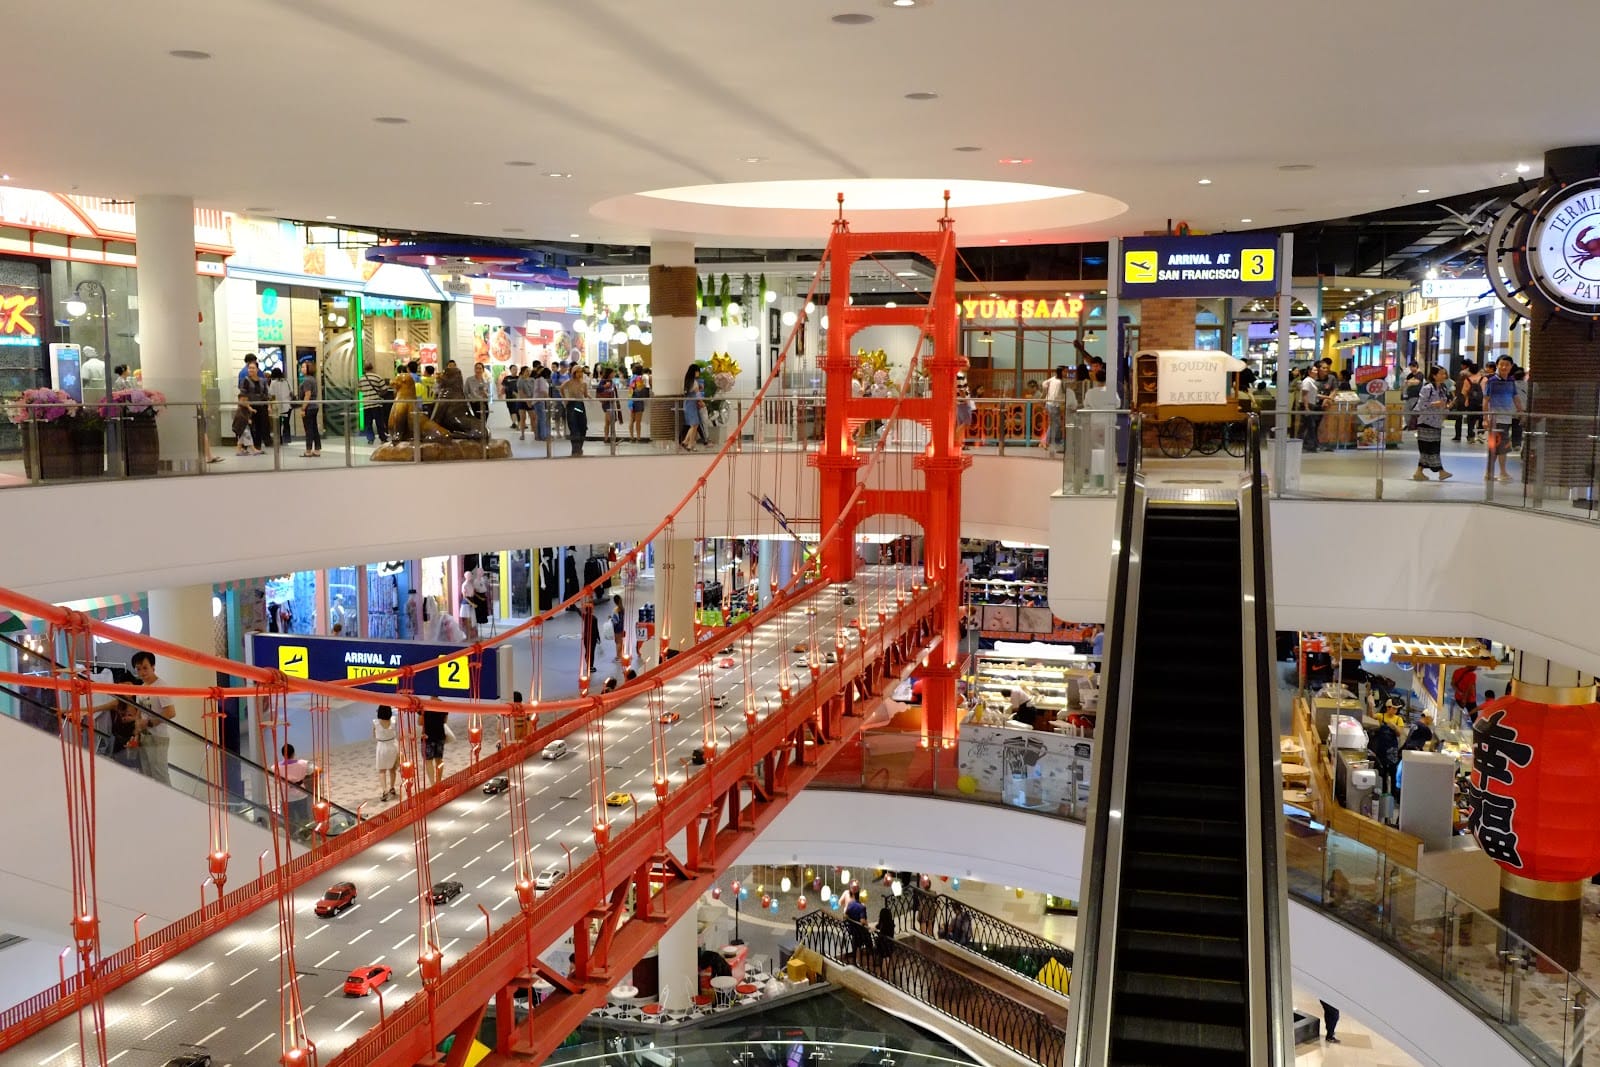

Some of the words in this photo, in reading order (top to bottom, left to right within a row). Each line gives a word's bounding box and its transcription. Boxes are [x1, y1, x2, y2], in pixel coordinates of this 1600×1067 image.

[1549, 194, 1600, 233] TERMI
[1168, 254, 1212, 266] ARRIVAL
[1216, 253, 1231, 265] AT
[1251, 254, 1264, 276] 3
[1158, 269, 1179, 281] SAN
[1182, 268, 1239, 280] FRANCISCO
[1552, 267, 1573, 285] OF
[962, 299, 1017, 319] YUM
[1021, 299, 1083, 319] SAAP
[1170, 361, 1218, 373] BOUDIN
[1169, 391, 1220, 403] BAKERY
[344, 652, 385, 665] ARRIVAL
[389, 655, 402, 666] AT
[447, 661, 460, 683] 2
